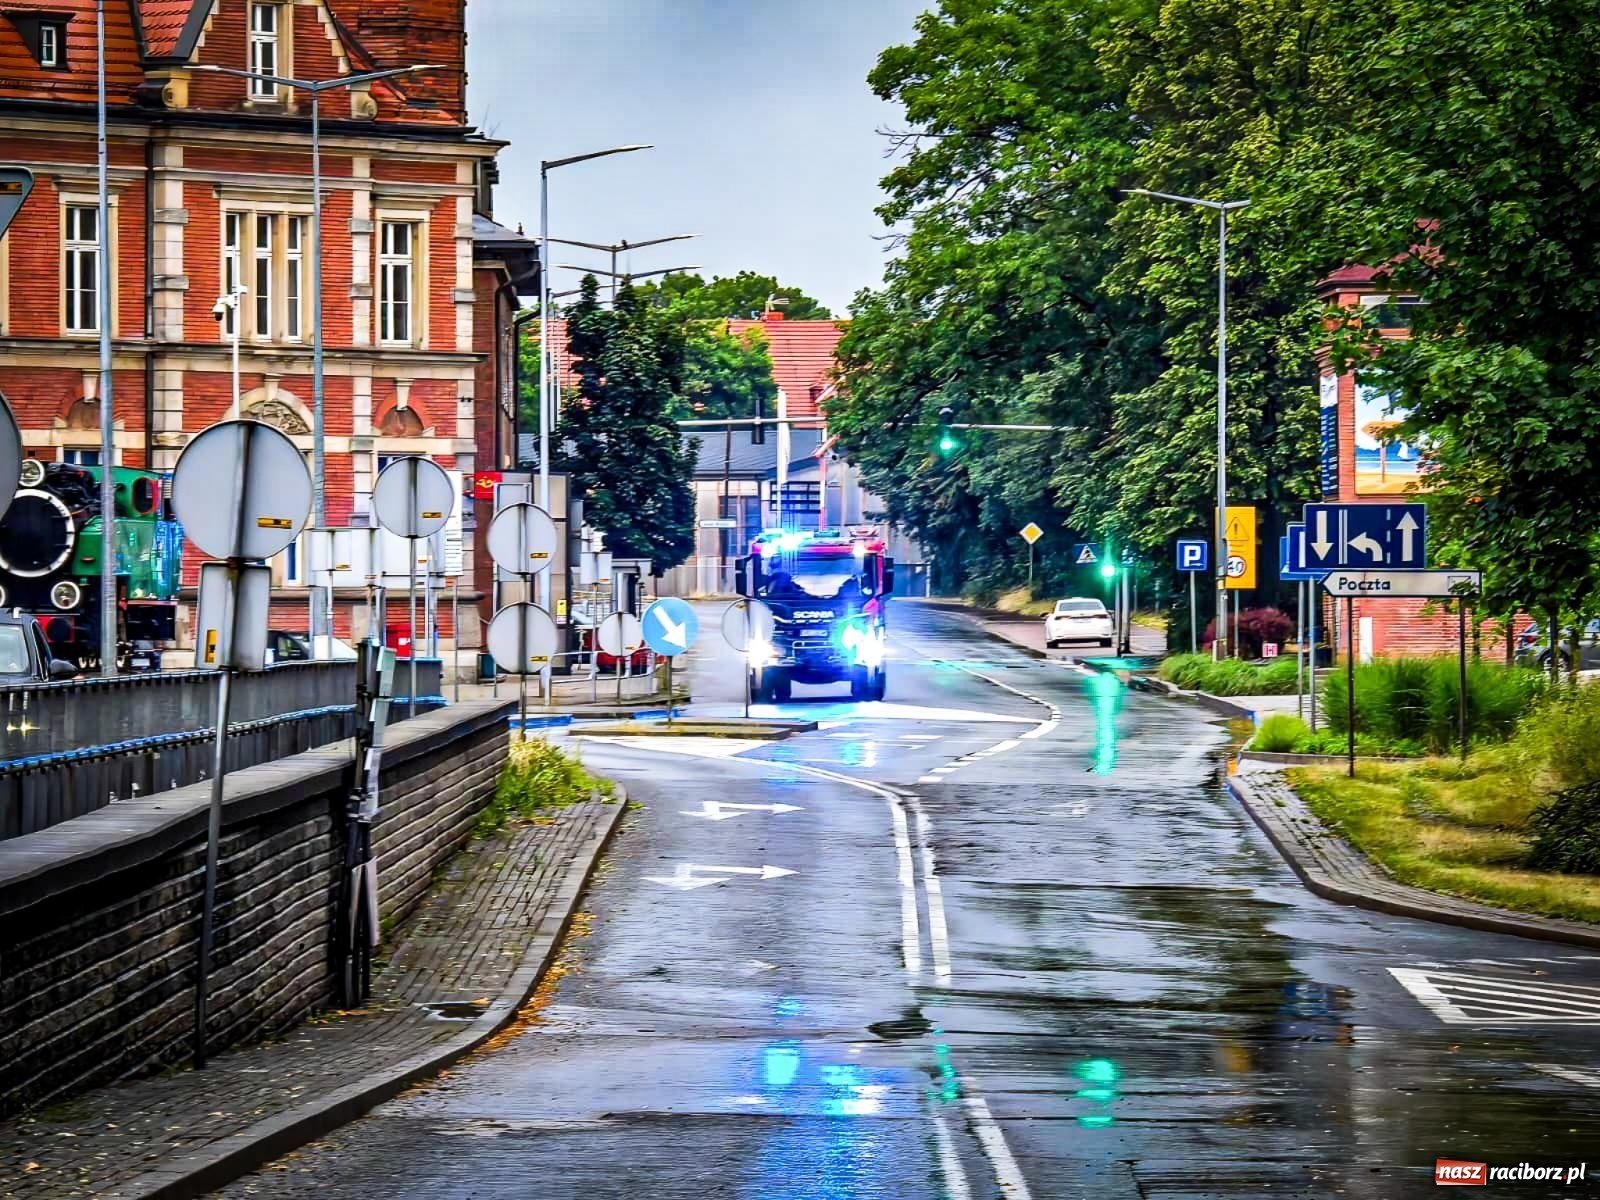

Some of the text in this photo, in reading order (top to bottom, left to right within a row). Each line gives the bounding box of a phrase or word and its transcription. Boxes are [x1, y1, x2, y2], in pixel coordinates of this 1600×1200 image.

[1184, 545, 1201, 567] P
[1338, 577, 1391, 591] Poczta
[793, 610, 835, 619] SCANIA
